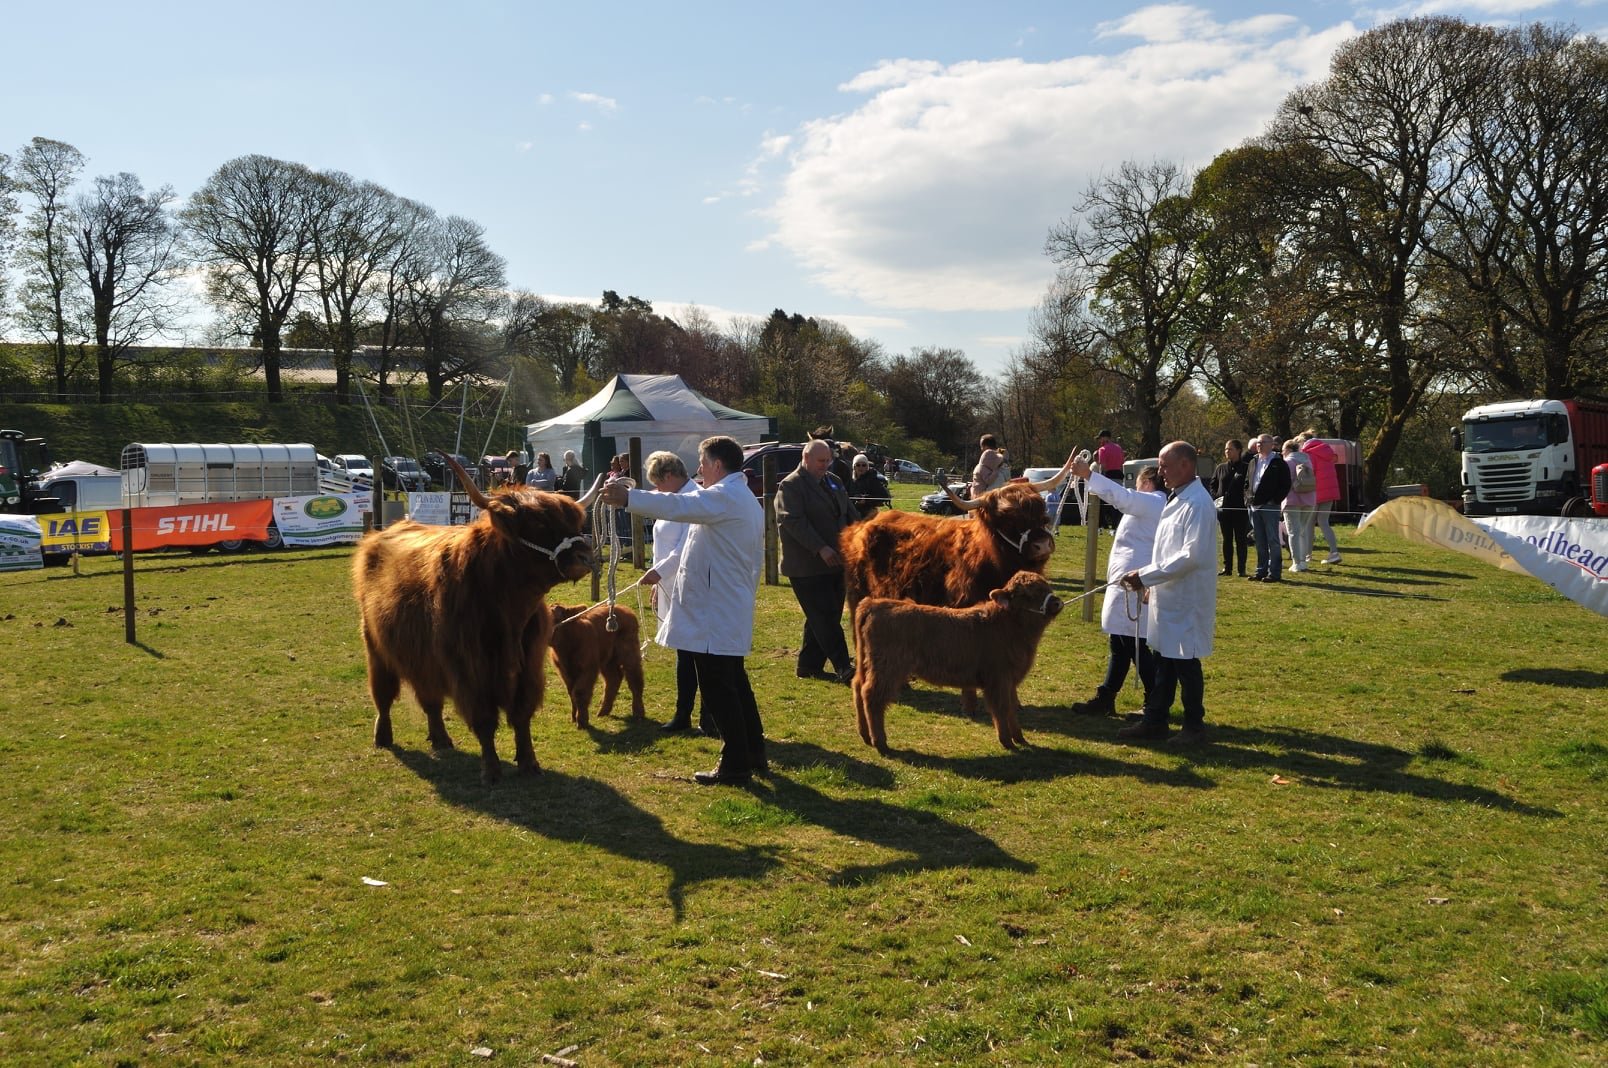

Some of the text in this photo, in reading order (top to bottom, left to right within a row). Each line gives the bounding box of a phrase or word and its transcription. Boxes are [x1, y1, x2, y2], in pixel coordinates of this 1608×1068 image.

[48, 518, 100, 537] IAE
[156, 514, 235, 535] STIHL
[1516, 531, 1608, 575] odhead
